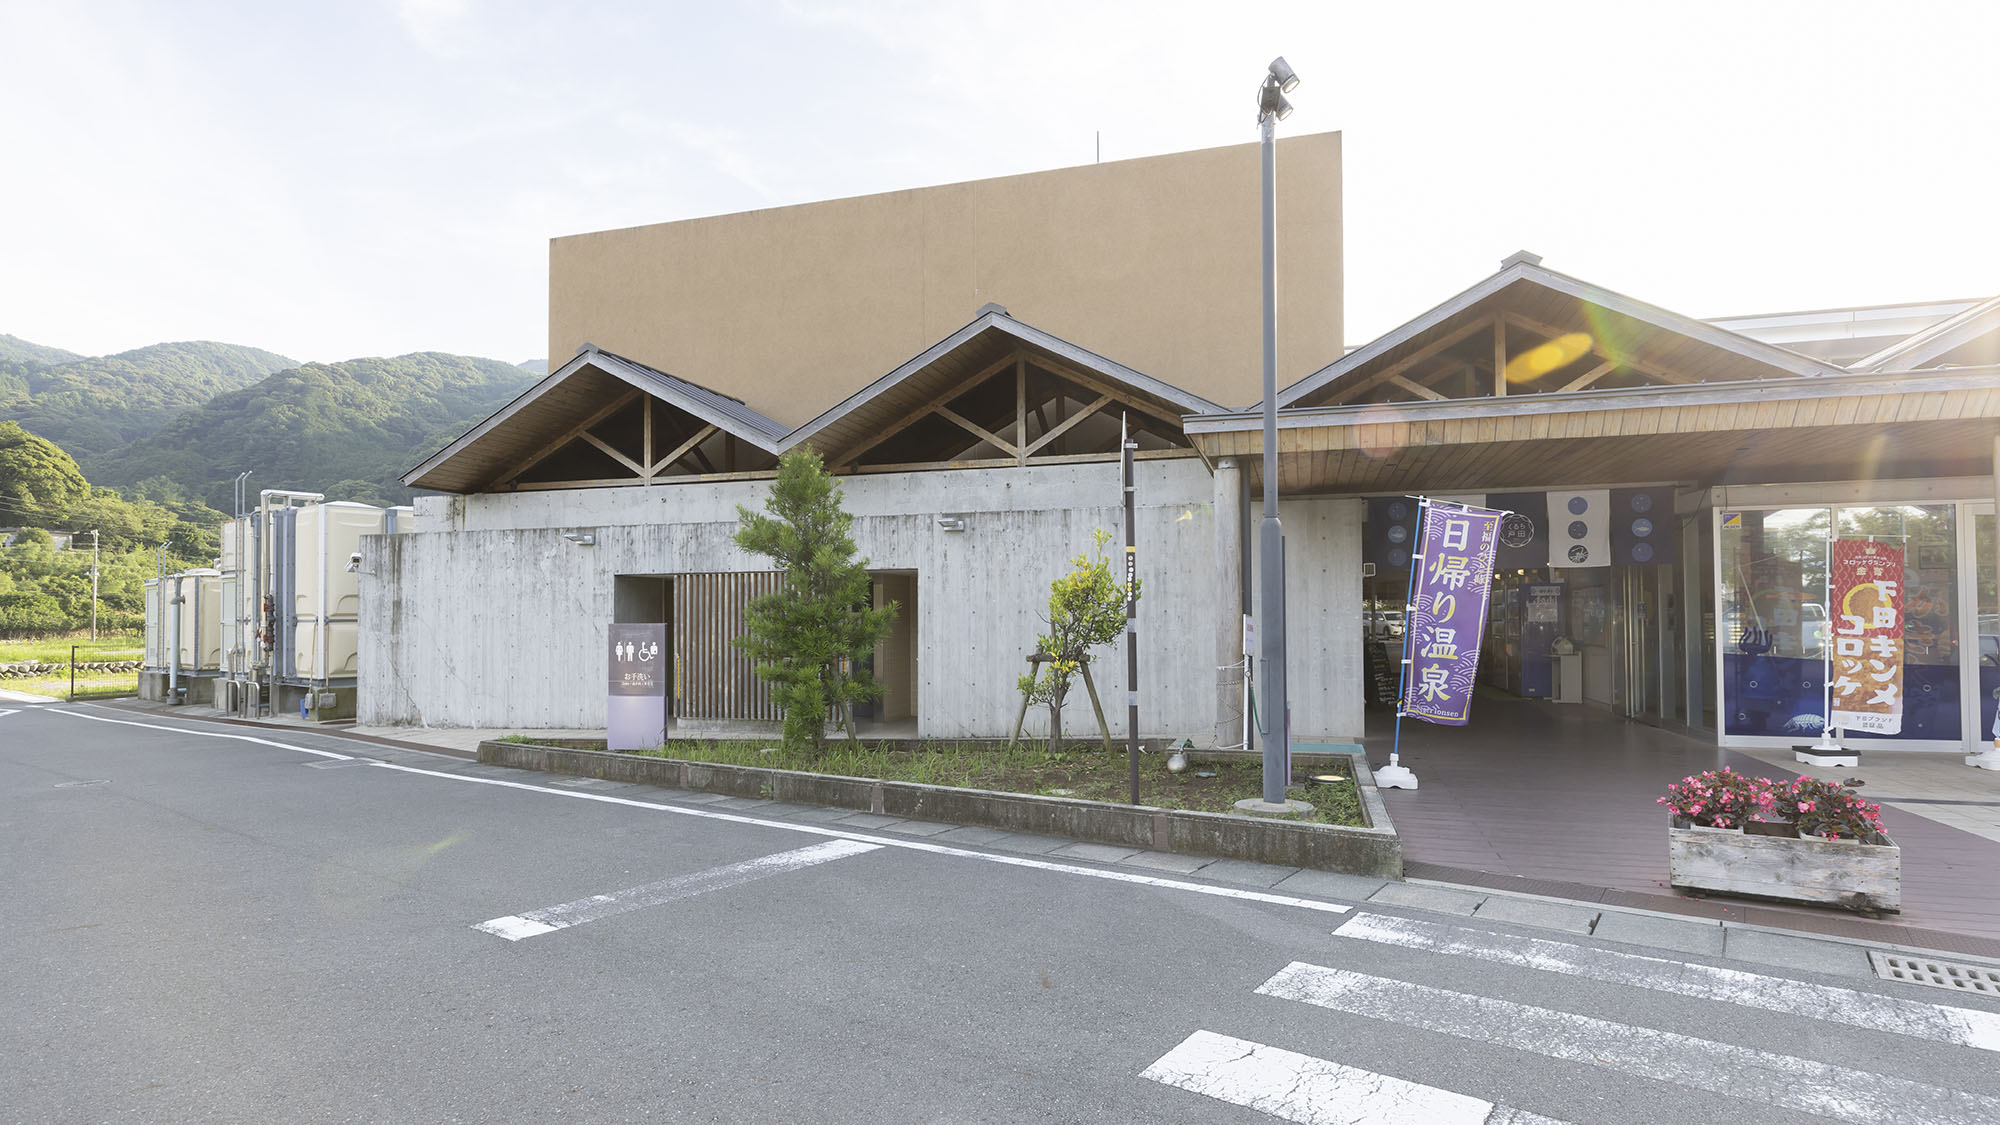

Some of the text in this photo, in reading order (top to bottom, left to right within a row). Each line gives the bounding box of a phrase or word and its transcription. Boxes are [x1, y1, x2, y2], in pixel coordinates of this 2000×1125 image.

[1508, 522, 1526, 530] くるら
[1507, 530, 1526, 538] 戸田
[1842, 559, 1896, 568] コロッケグランプリ
[1418, 519, 1470, 702] 日帰り温泉
[1866, 579, 1898, 706] 下田キンメ
[1833, 614, 1865, 696] コロッケ
[624, 672, 651, 681] お手洗い
